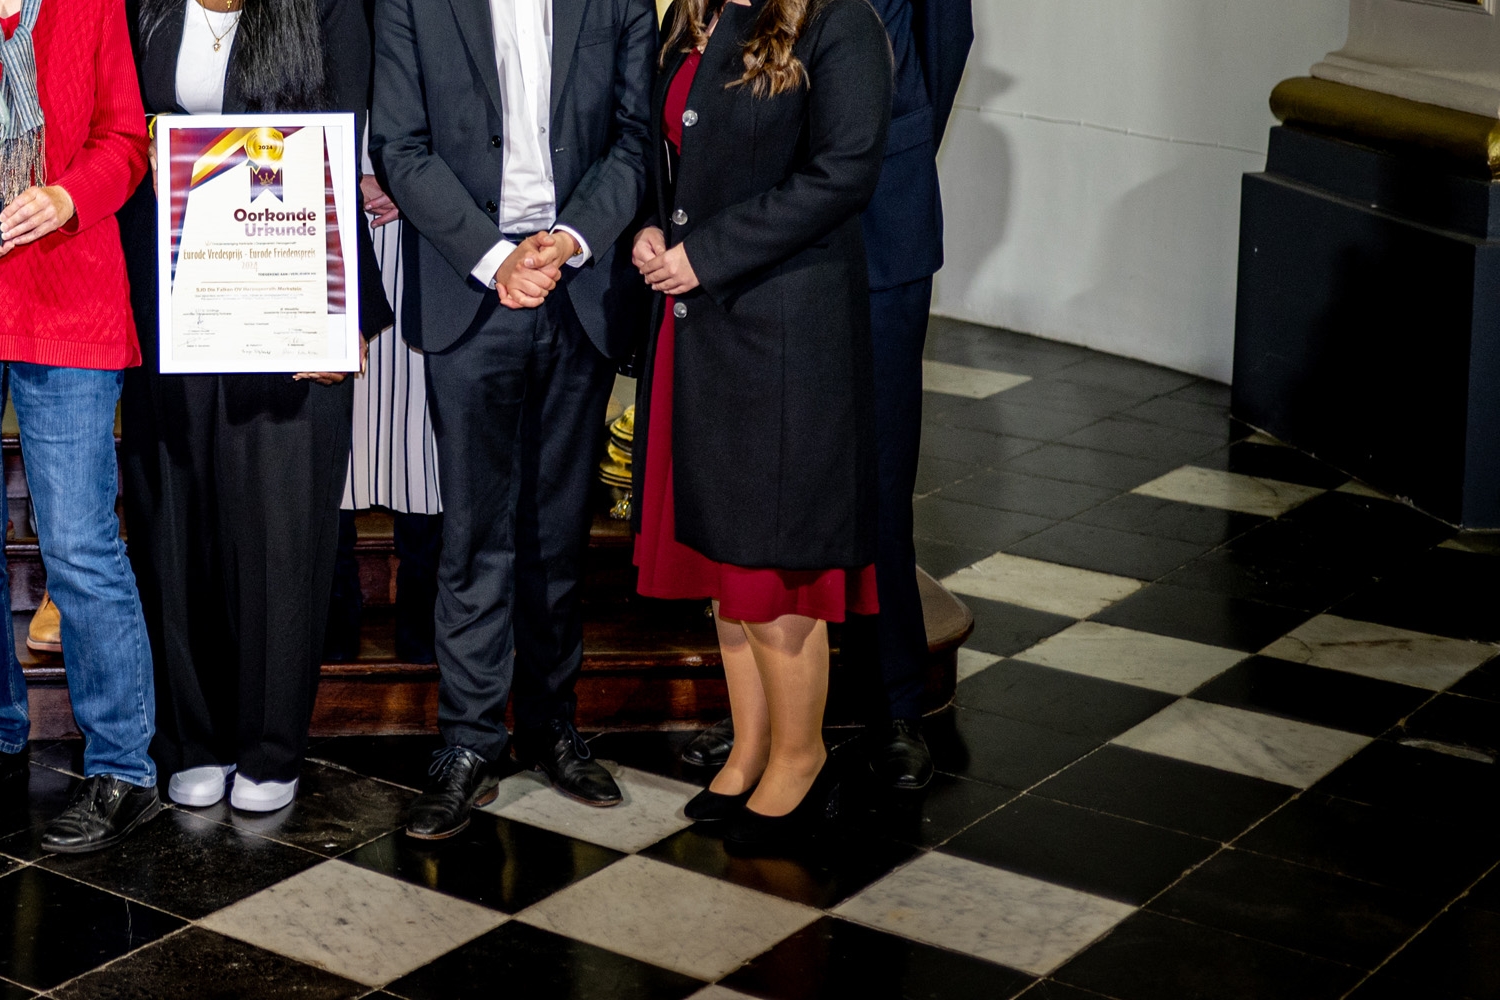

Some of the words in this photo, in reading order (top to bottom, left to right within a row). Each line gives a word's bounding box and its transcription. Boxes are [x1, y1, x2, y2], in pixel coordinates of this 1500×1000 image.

[233, 207, 317, 222] Oorkonde
[244, 222, 317, 237] Urkunde
[183, 249, 206, 260] Eurode
[207, 248, 243, 261] Vredesprijs
[249, 247, 272, 259] Eurode
[273, 247, 316, 260] Friedenspreis
